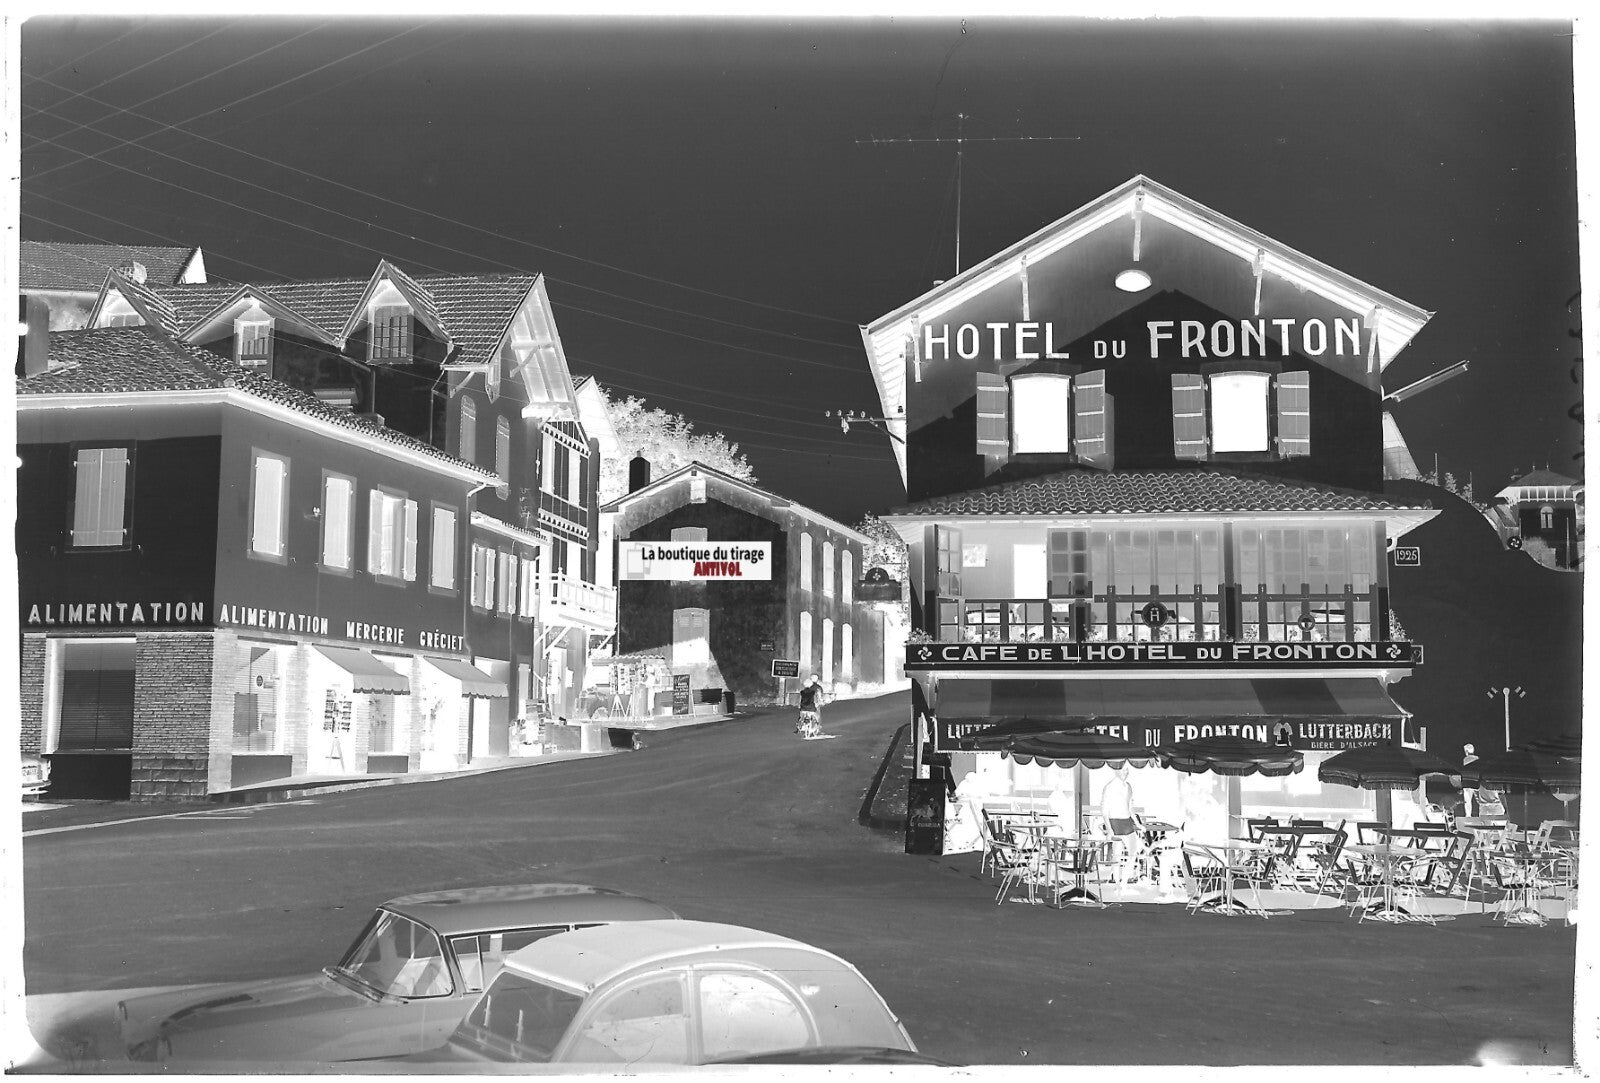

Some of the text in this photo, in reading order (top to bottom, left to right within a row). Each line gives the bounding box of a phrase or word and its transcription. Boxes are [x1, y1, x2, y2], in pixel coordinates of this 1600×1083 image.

[924, 318, 1361, 360] HOTEL DU FRONTON
[28, 602, 205, 623] ALIMENTATION
[219, 604, 328, 635] ALIMENTATION
[346, 621, 404, 645] MERCERIE
[942, 646, 1018, 661] CAFE
[1028, 649, 1053, 660] DE
[1196, 648, 1222, 659] DU
[1233, 644, 1377, 660] FRONTON
[1145, 729, 1160, 747] DU
[1299, 723, 1392, 740] LUTTERBACH
